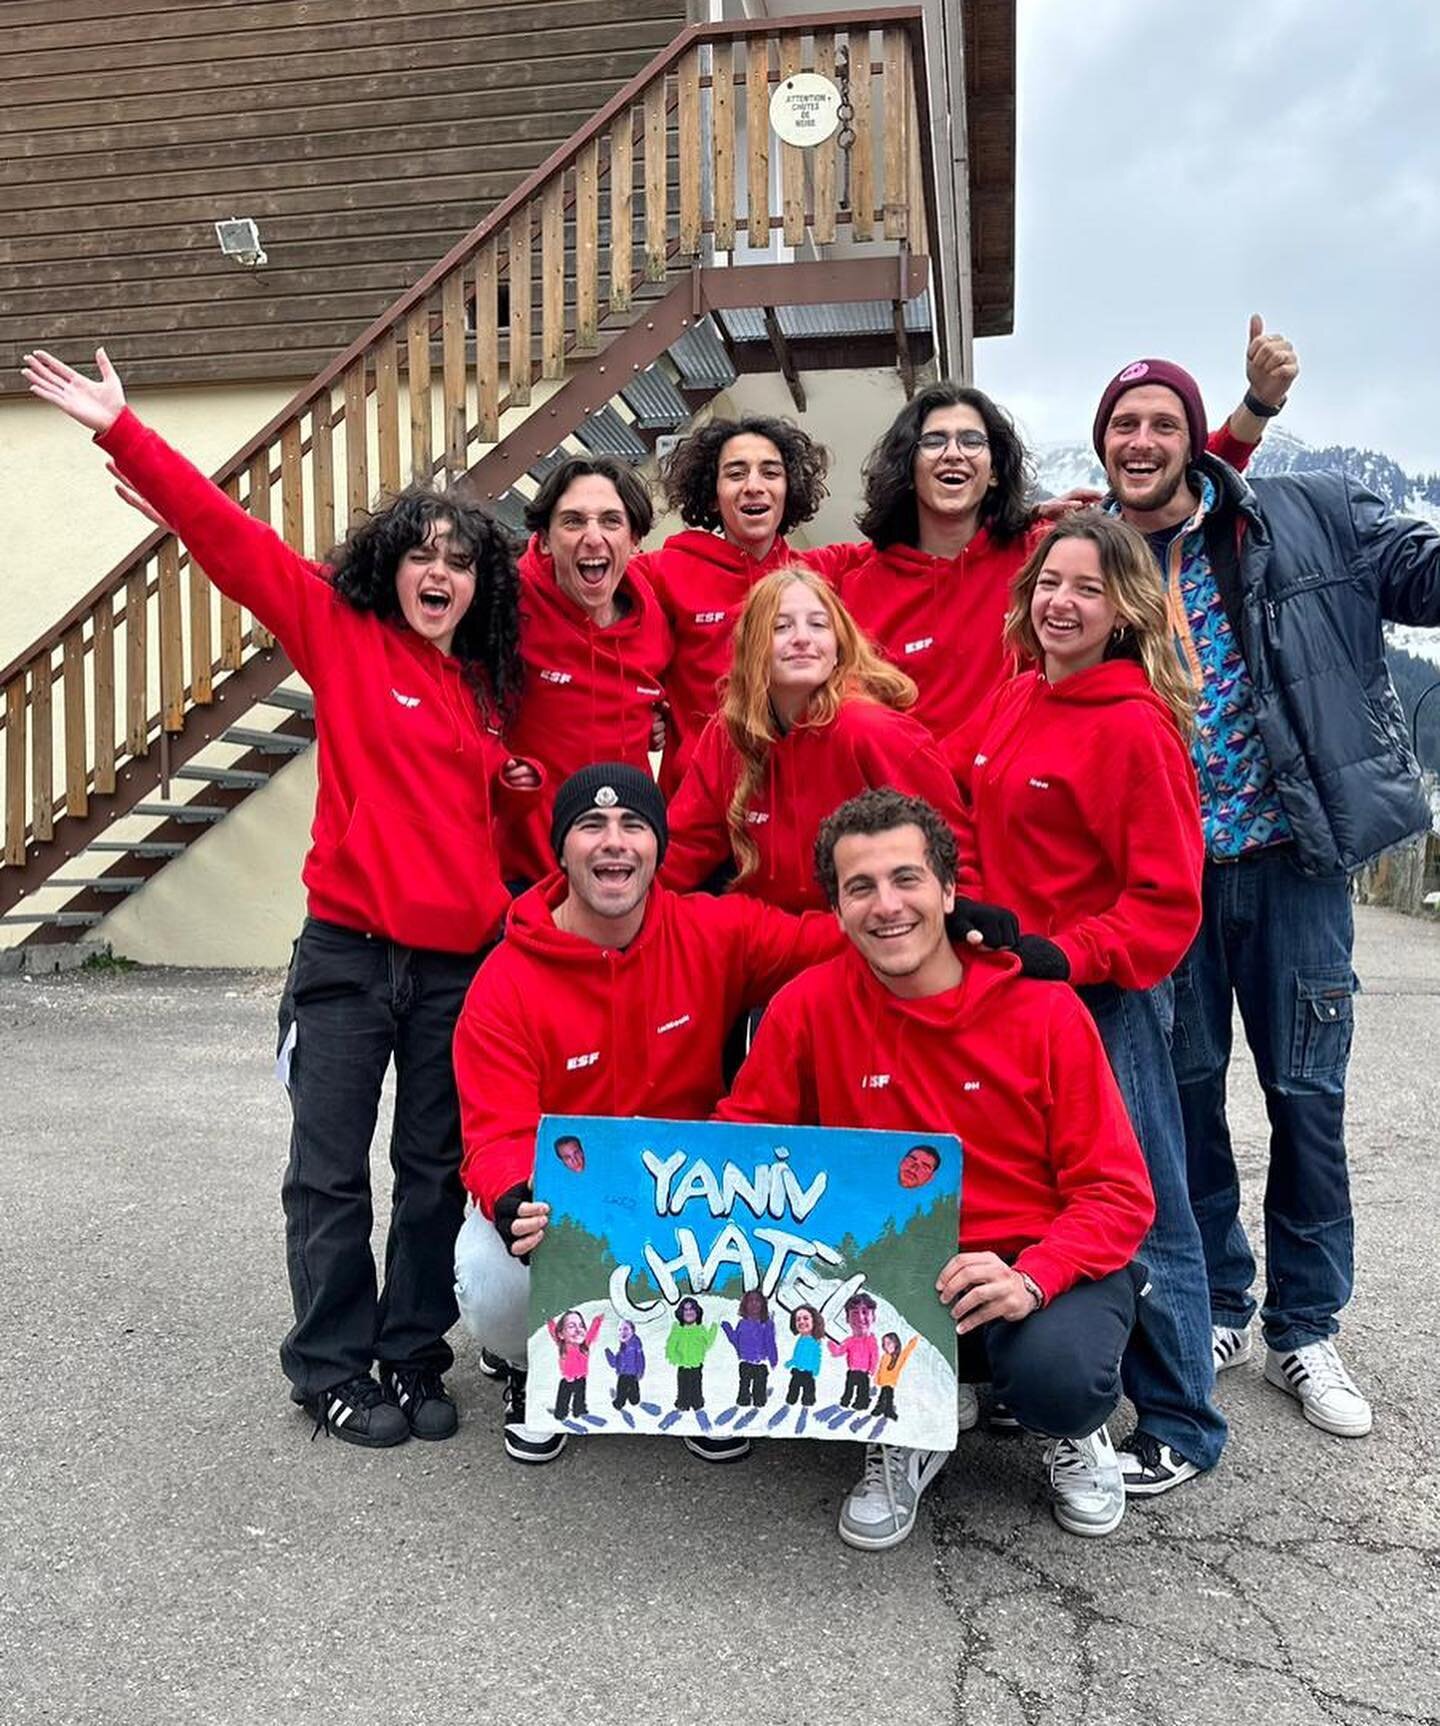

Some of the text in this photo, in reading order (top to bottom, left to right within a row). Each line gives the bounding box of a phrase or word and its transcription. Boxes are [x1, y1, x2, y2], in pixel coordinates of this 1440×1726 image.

[695, 611, 726, 623] ESF
[904, 637, 933, 655] ESF
[540, 669, 573, 684] ESF
[748, 811, 770, 824] SF
[566, 1051, 600, 1071] ESF
